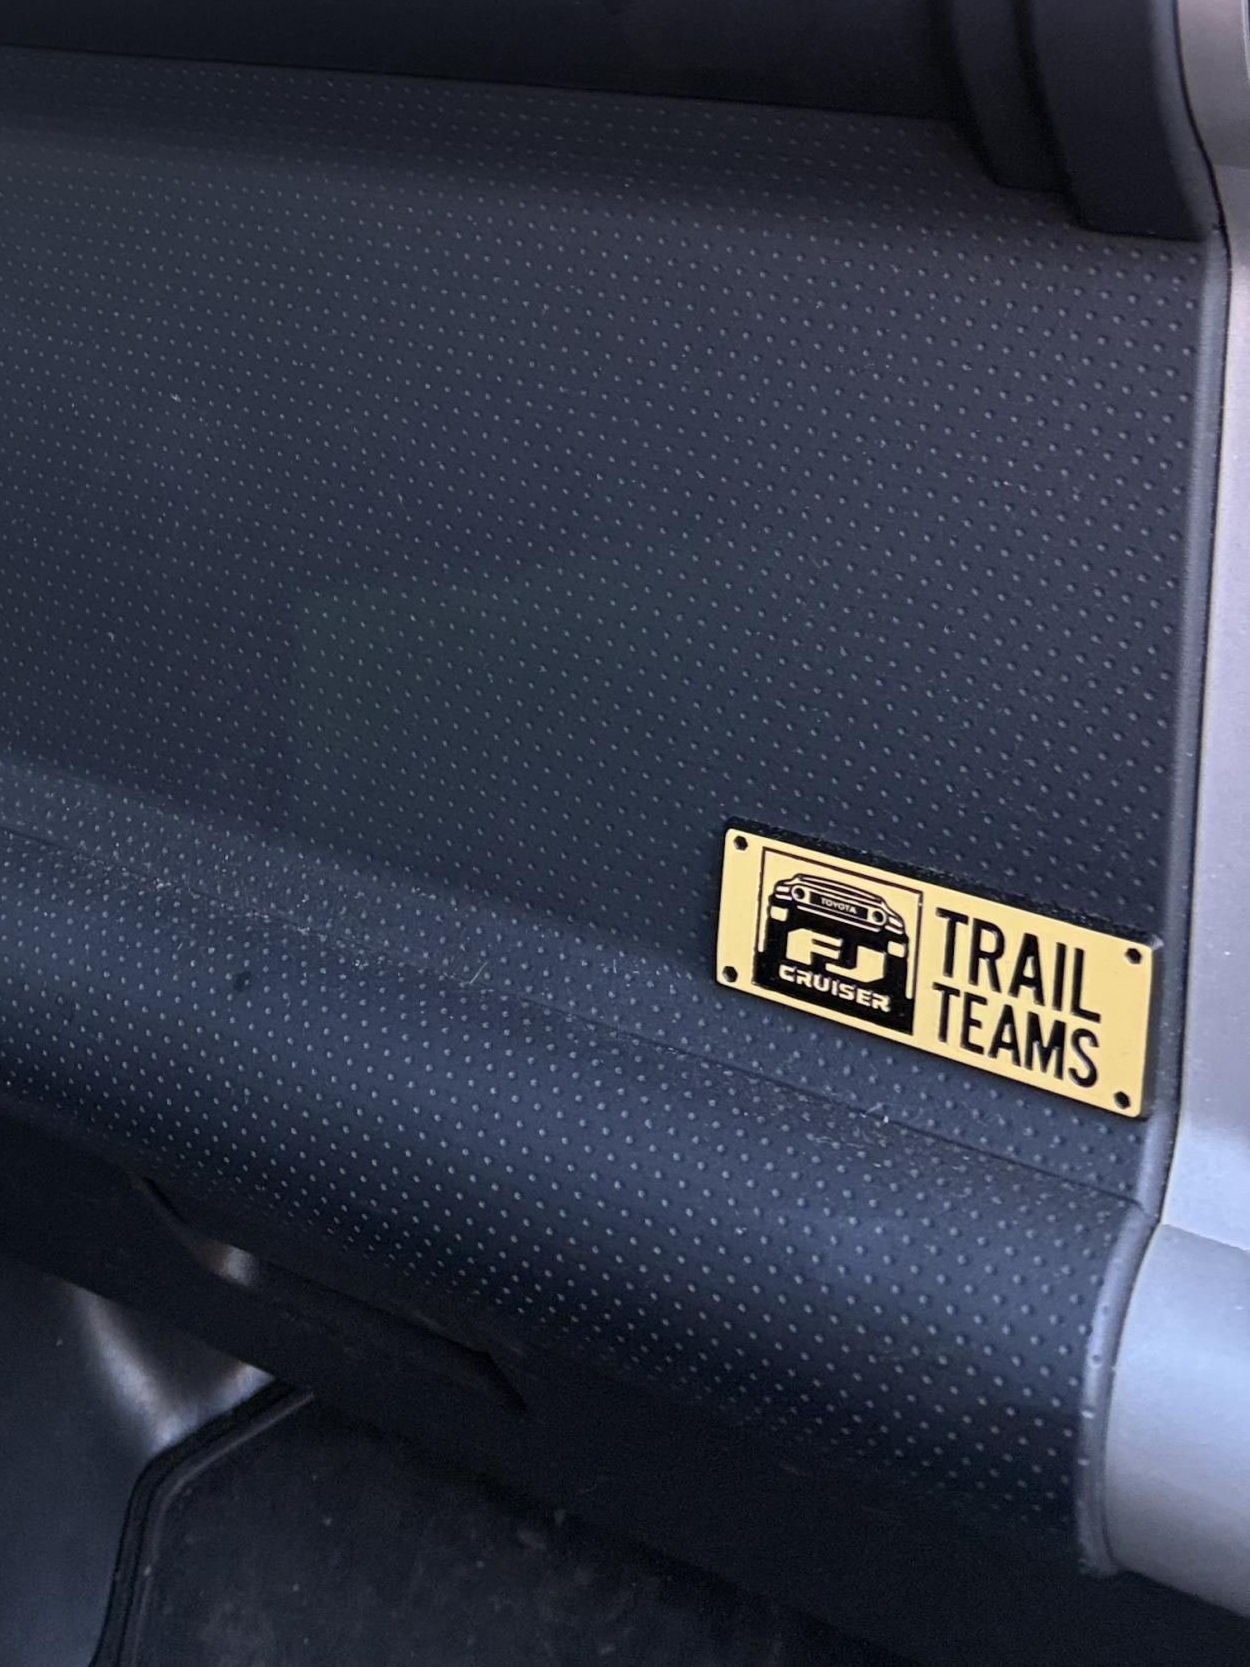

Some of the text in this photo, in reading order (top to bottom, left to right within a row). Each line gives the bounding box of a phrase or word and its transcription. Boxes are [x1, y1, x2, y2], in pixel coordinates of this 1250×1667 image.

[820, 896, 858, 915] TOYOTA
[785, 928, 887, 983] FJ
[935, 906, 1102, 1023] TRAIL
[778, 963, 891, 1013] CRUISER
[932, 981, 1099, 1088] TEAMS
